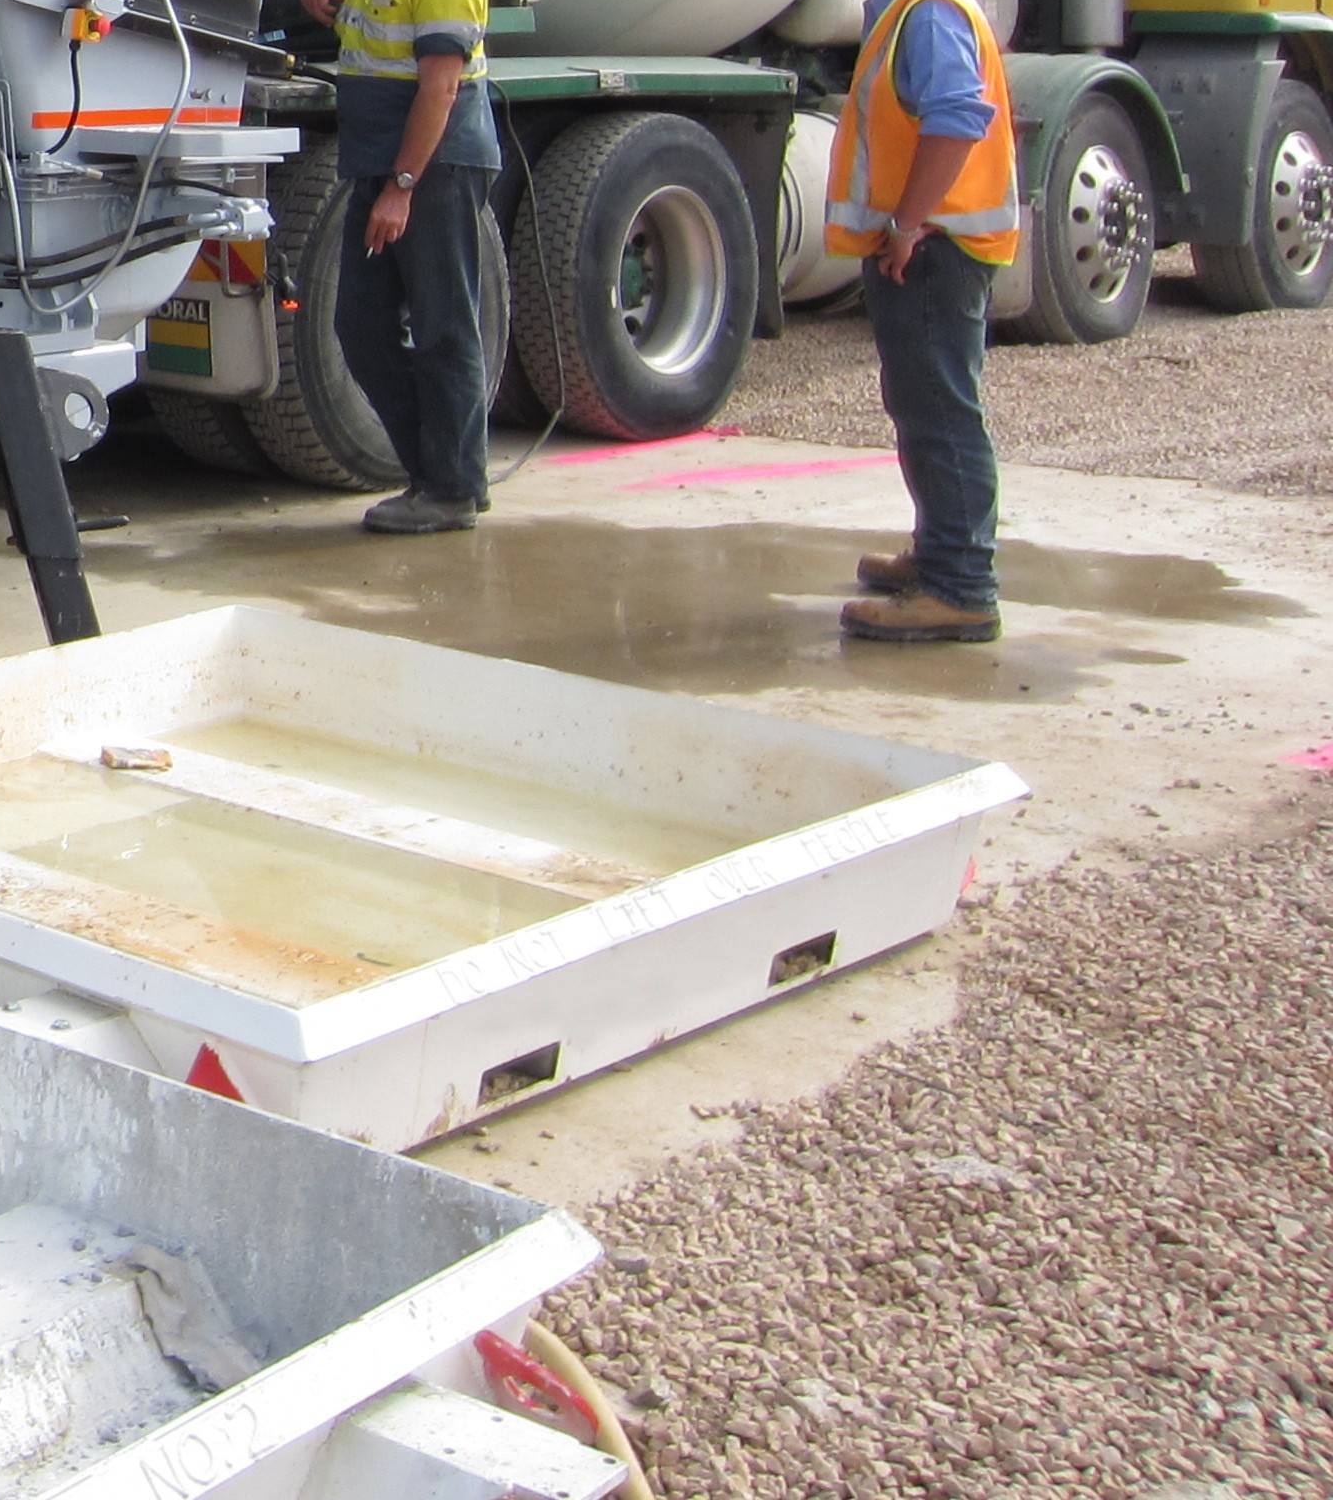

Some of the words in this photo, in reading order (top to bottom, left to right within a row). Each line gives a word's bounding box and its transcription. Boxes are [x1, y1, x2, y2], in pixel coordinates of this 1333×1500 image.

[153, 300, 209, 322] ORAL
[497, 929, 571, 980] NOT
[591, 886, 679, 942] LIFT
[703, 854, 777, 900] OVER
[800, 808, 903, 868] PEOPLE
